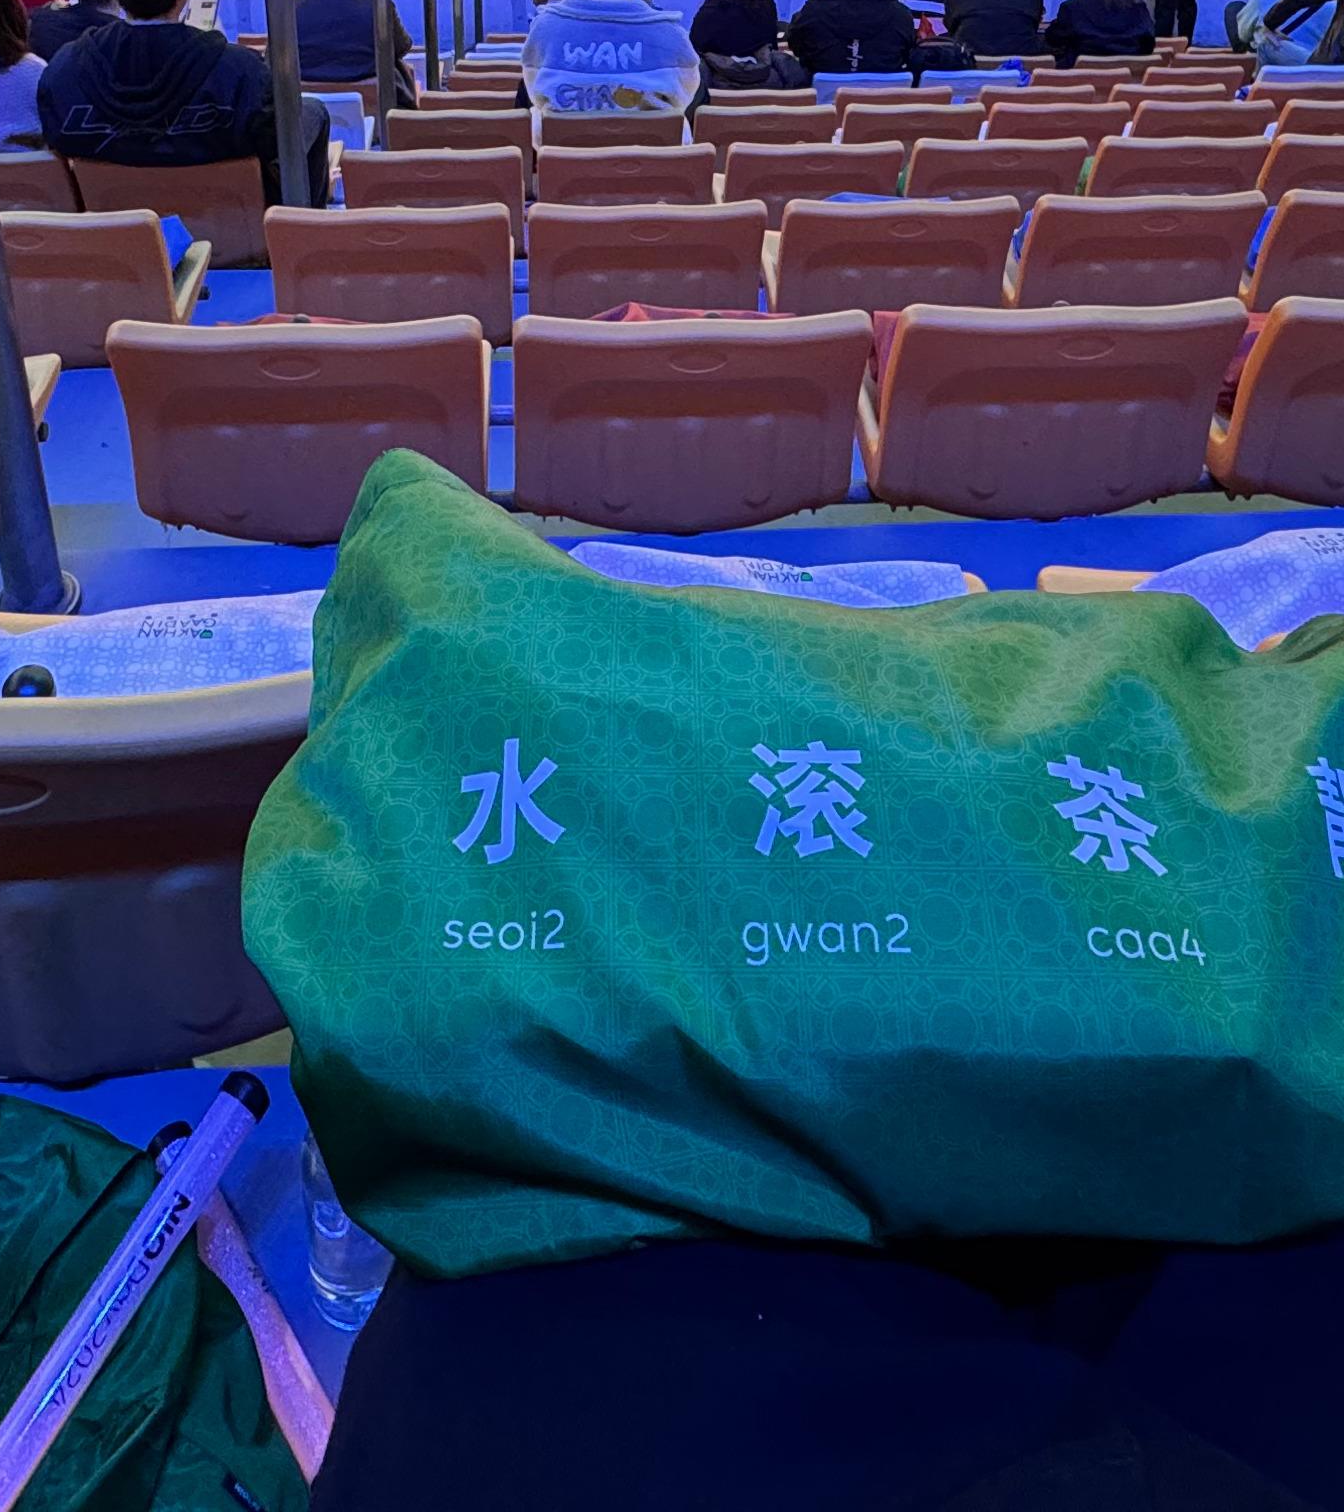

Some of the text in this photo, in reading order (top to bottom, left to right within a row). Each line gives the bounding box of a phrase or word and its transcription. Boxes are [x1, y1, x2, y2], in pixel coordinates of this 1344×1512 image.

[562, 41, 642, 70] WAN
[443, 909, 566, 951] seoi2
[742, 913, 912, 966] gwan2
[1087, 925, 1206, 966] caa4
